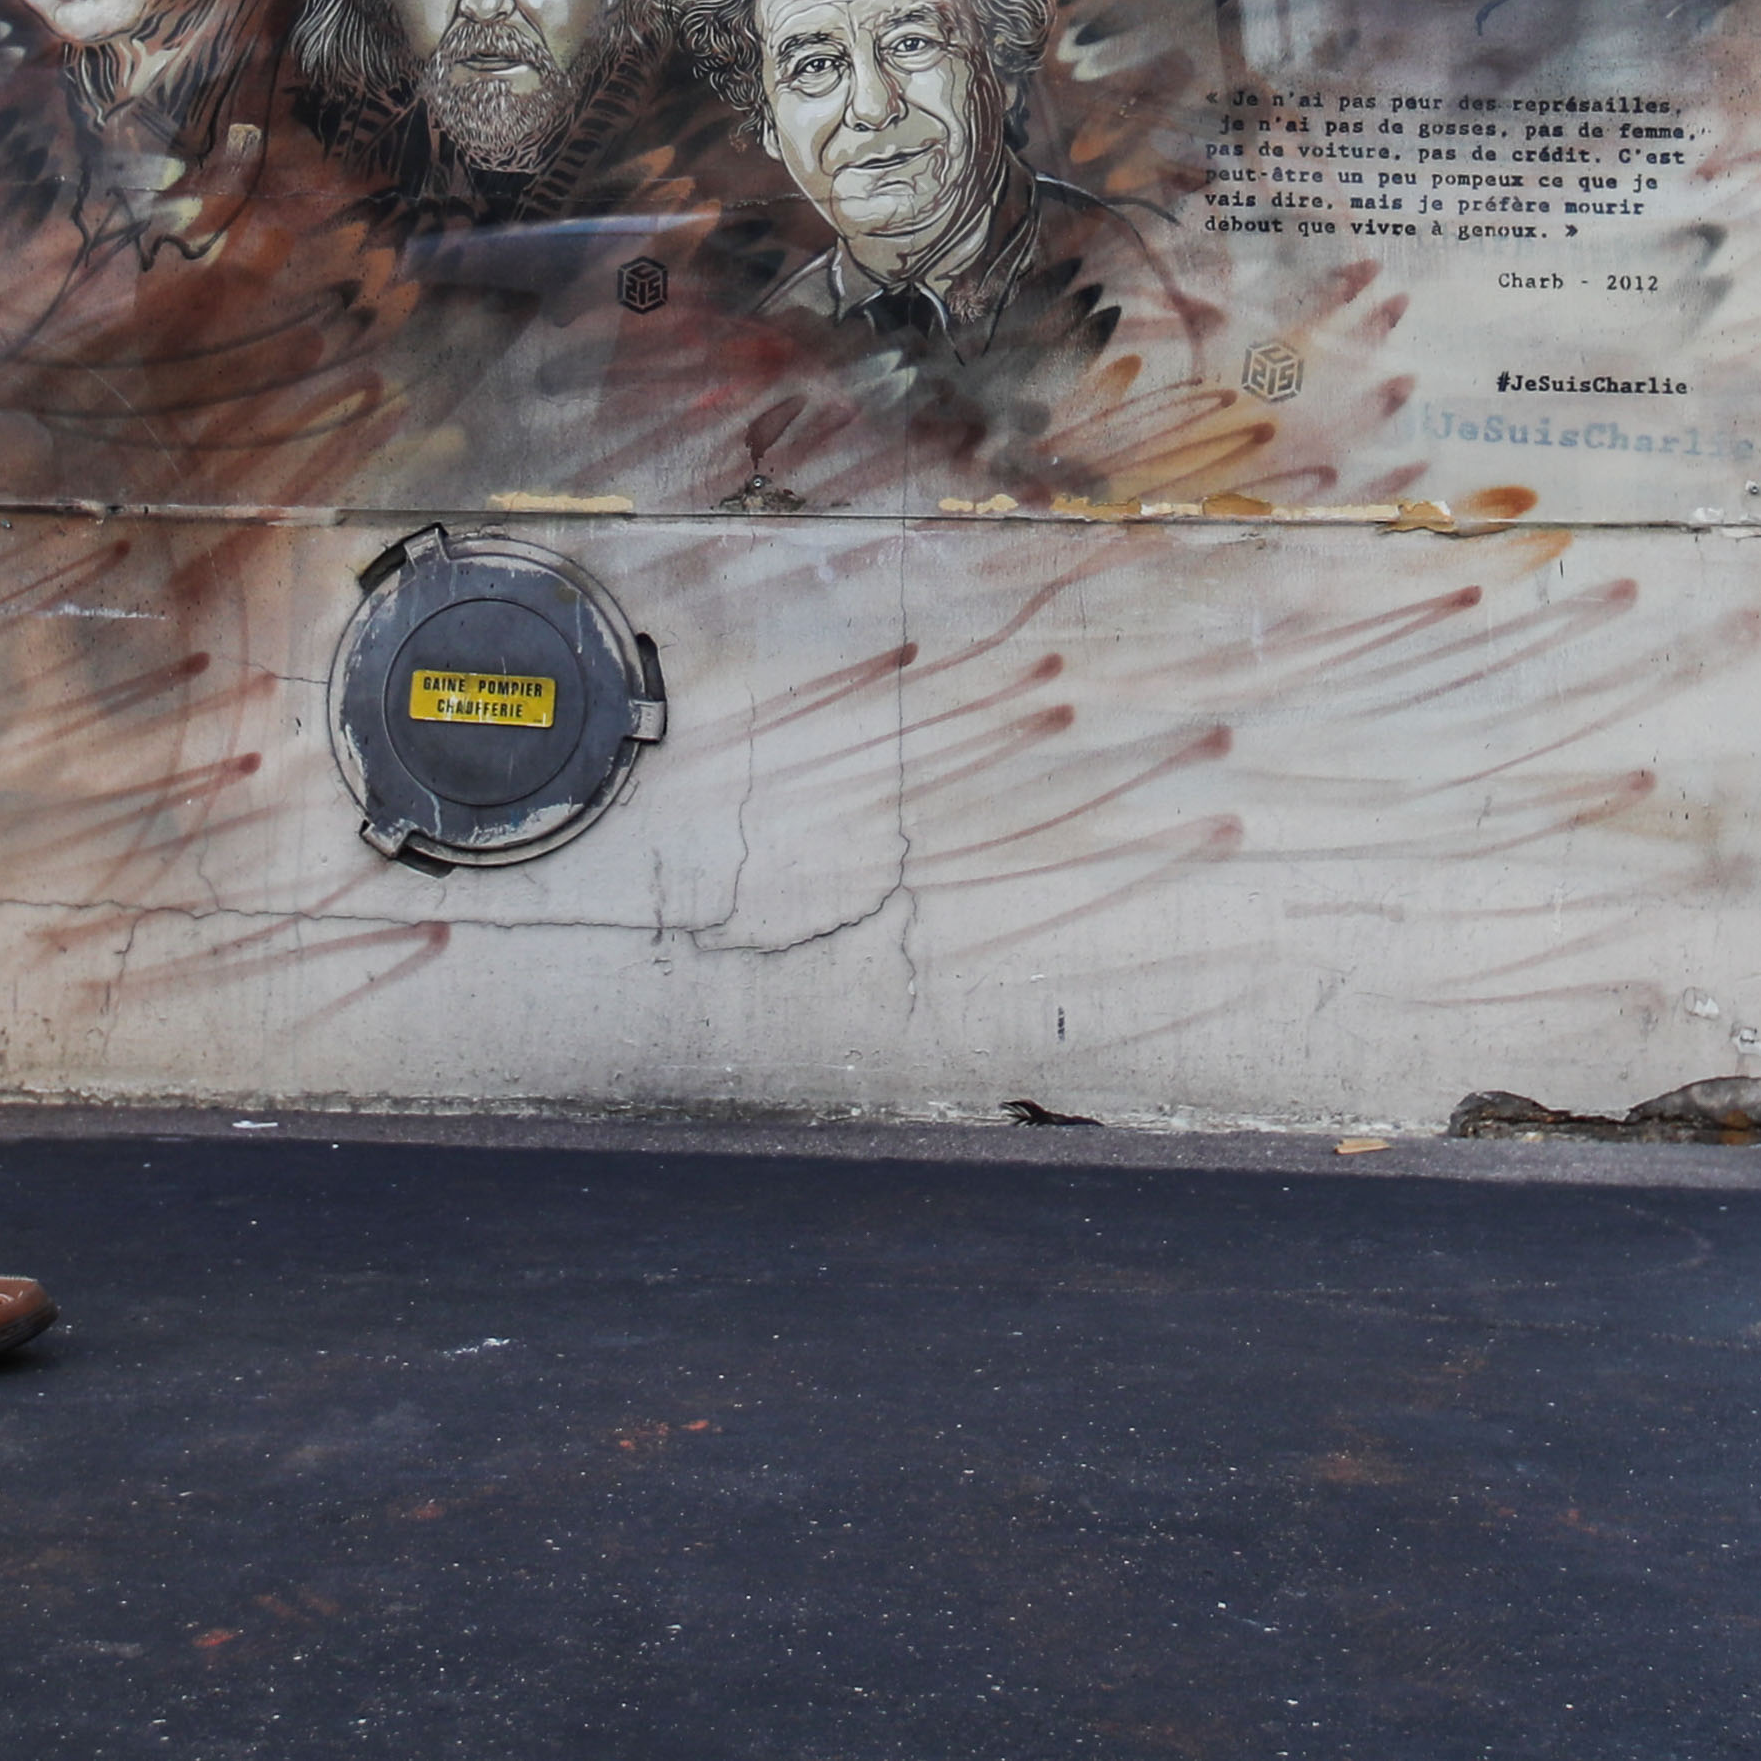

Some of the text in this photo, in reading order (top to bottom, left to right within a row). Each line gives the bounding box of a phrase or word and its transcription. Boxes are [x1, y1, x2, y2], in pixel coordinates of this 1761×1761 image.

[1233, 91, 1258, 106] Je
[1273, 91, 1324, 108] n'ai
[1339, 95, 1377, 111] pas
[1391, 95, 1443, 113] peur
[1459, 95, 1497, 111] des
[1219, 116, 1244, 134] je
[1259, 116, 1310, 132] n'ai
[1325, 119, 1364, 136] pas
[1378, 117, 1404, 134] de
[1526, 124, 1563, 140] pas
[1579, 122, 1603, 138] de
[1206, 142, 1244, 159] pas
[1258, 141, 1284, 157] de
[1419, 147, 1456, 163] pas
[1472, 145, 1496, 161] de
[1512, 147, 1601, 164] crédit.
[1618, 148, 1685, 165] C'est
[1206, 167, 1658, 193] peut-être un peu pompeux ce que je
[1205, 192, 1257, 208] vais
[1350, 194, 1403, 210] mais
[1418, 195, 1443, 214] je
[1458, 196, 1550, 215] préfère
[1565, 198, 1644, 215] mourir
[1298, 223, 1336, 237] que
[1351, 219, 1416, 236] vivre
[1430, 216, 1443, 236] à
[1458, 224, 1548, 240] genoux.
[1499, 273, 1564, 291] Charb
[1606, 274, 1660, 293] 2012
[1496, 371, 1688, 395] #JeSuisCharlie
[423, 676, 544, 698] GAINE POMPIER
[436, 699, 524, 718] CHAUFFERIE
